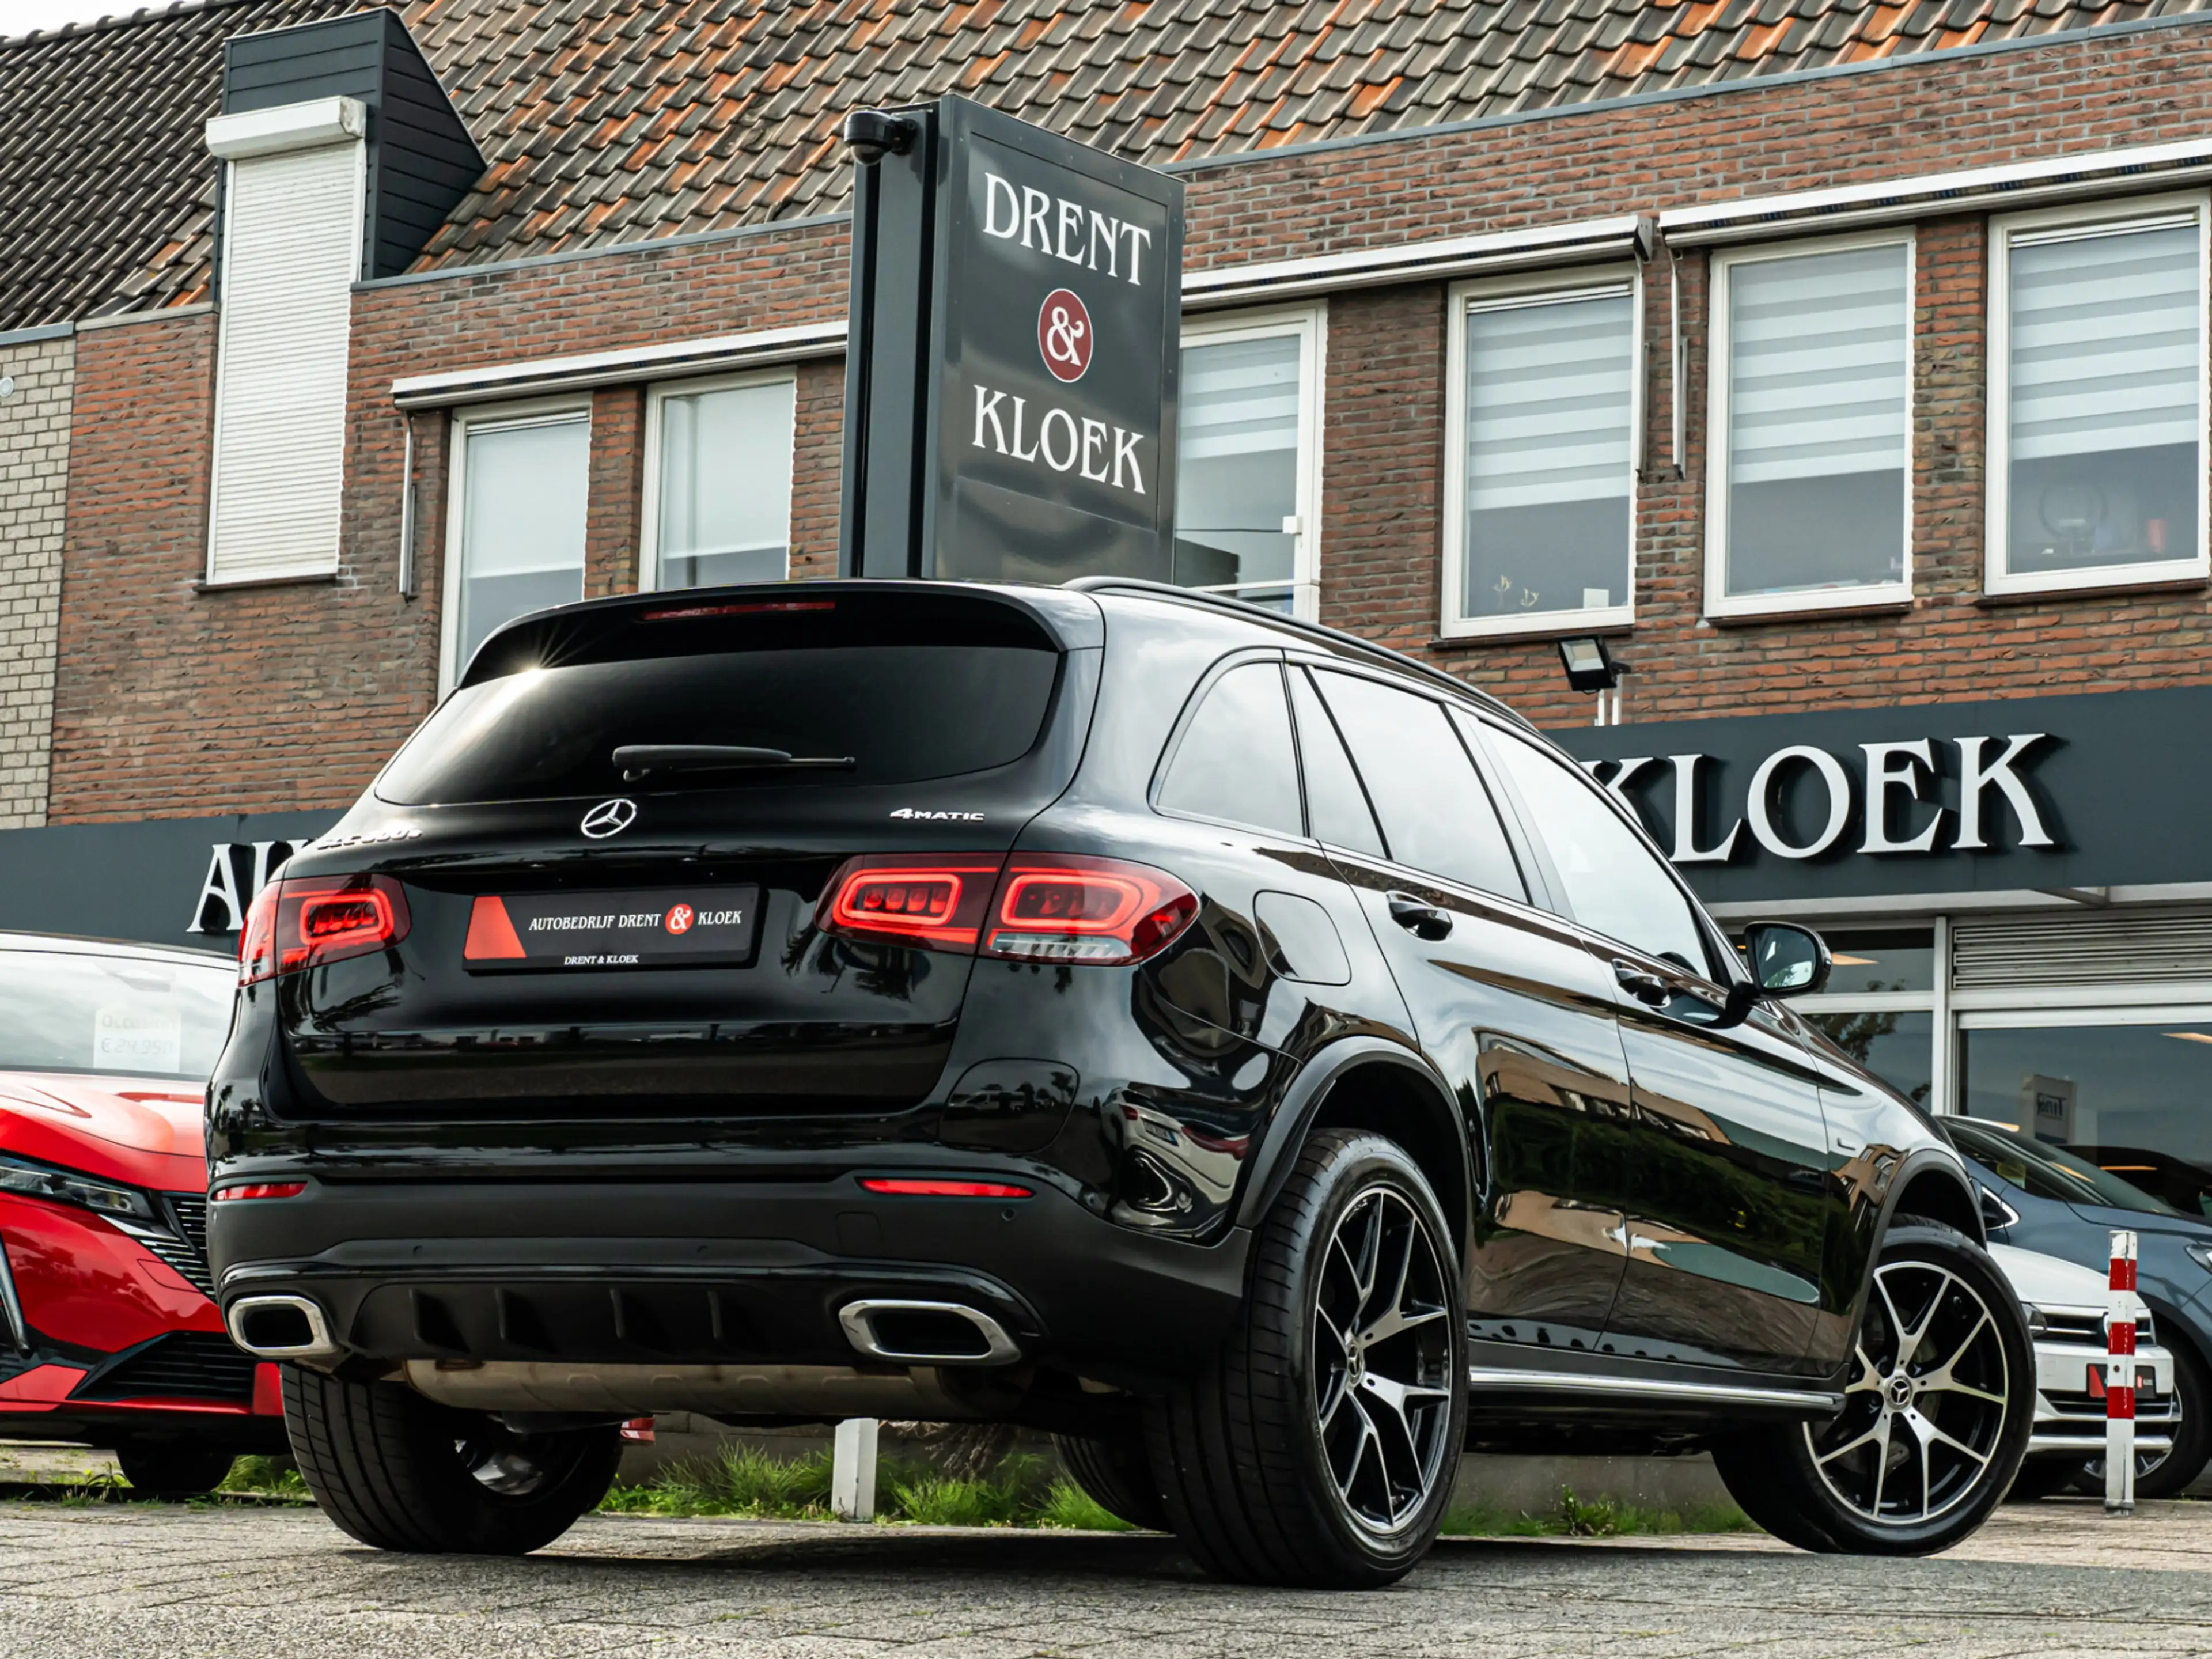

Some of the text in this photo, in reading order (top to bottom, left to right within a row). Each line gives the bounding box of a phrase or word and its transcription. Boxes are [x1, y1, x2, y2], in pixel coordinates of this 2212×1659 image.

[983, 172, 1152, 286] DRENT
[1046, 305, 1085, 368] &
[972, 384, 1146, 494] KLOEK
[889, 808, 984, 820] 4MATIC
[529, 907, 742, 930] AUTOBEDRIJF DRENT & KLOEK
[564, 955, 639, 965] DRENT & KLOEK
